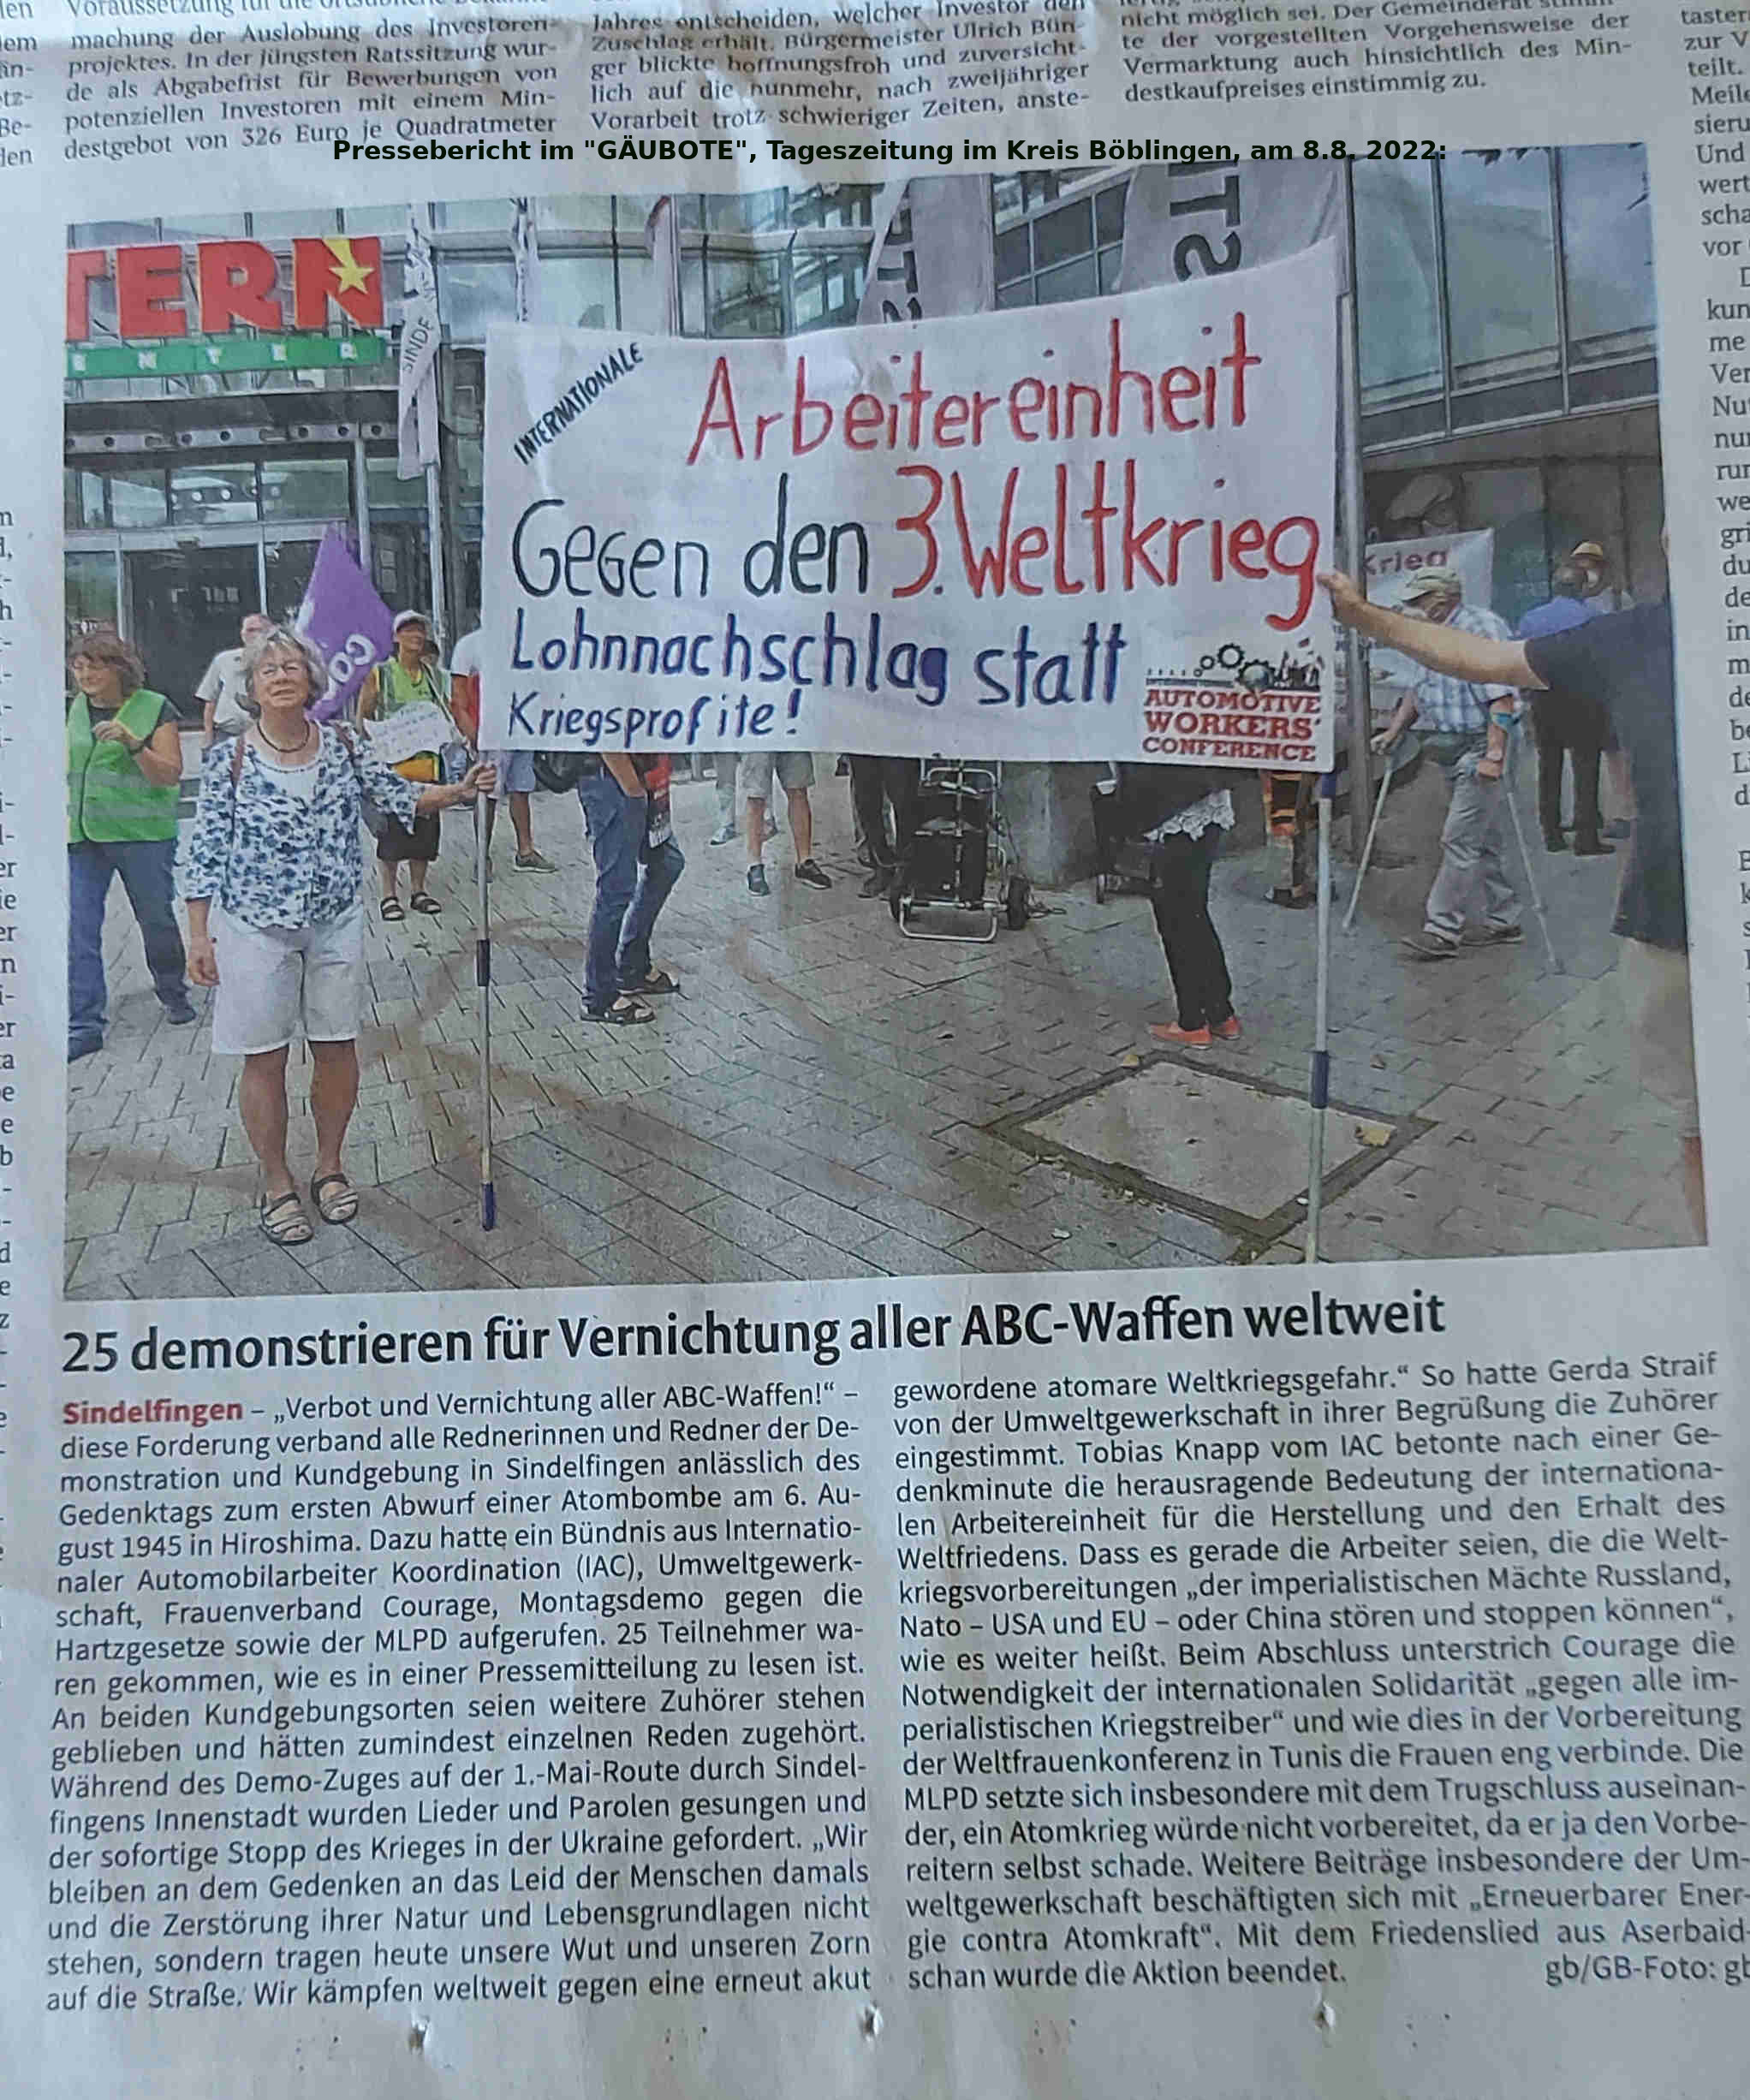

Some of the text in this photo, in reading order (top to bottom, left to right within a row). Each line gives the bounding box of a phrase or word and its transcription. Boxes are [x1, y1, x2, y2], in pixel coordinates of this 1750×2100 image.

[1122, 12, 1630, 51] te der vorgestellten Vorgehensweise der
[1684, 34, 1723, 51] zur
[1124, 38, 1633, 77] Vermarktung auch hinsichtlich des Min-
[1688, 57, 1743, 78] teilt.
[66, 64, 558, 104] de als Abgabefrist für Bewerbungen von
[648, 80, 686, 100] auf
[699, 80, 734, 100] die
[878, 77, 932, 99] nach
[948, 62, 1090, 91] zweijähriger
[1124, 72, 1486, 104] destkaufpreises einstimmig zu.
[65, 87, 557, 135] potenziellen Investoren mit einem Min-
[592, 108, 699, 132] Vorarbeit
[780, 104, 911, 131] schwieriger
[923, 97, 1004, 120] Zeiten,
[1016, 89, 1091, 110] anste-
[64, 116, 557, 163] destgebot von 326 Euro je Quadratmeter
[1696, 142, 1746, 165] Und
[1703, 238, 1741, 258] vor
[66, 236, 384, 342] TERN
[1709, 334, 1746, 353] me
[514, 342, 644, 466] INTERNATIONALE
[686, 311, 1263, 466] Arbeitereinheit
[743, 472, 869, 598] den
[512, 606, 1128, 709] Lohnnachschlag statt
[509, 687, 803, 749] Kriegsprofite!
[1143, 688, 1322, 715] AUTOMOTIVE
[1142, 735, 1317, 763] CONFERENCE
[62, 1287, 1447, 1372] 25 demonstrieren für Vernichtung aller ABC-Waffen weltweit
[62, 1398, 242, 1428] Sindelfingen
[274, 1395, 372, 1424] „Verbot
[380, 1392, 428, 1417] und
[437, 1389, 592, 1417] Vernichtung
[600, 1385, 657, 1410] aller
[894, 1389, 1718, 1437] von der Umweltgewerkschaft in ihrer Begrüßung die Zuhörer
[60, 1482, 861, 1529] Gedenktags zum ersten Abwurf einer Atombombe am 6. Au-
[57, 1581, 863, 1630] schaft, Frauenverband Courage, Montagsdemo gegen die
[900, 1559, 1731, 1609] kriegsvorbereitungen „der imperialistischen Mächte Russland,
[51, 1683, 864, 1731] An beiden Kundgebungsorten seien weitere Zuhörer stehen
[902, 1665, 1739, 1711] Notwendigkeit der internationalen Solidarität „gegen alle im-
[51, 1752, 866, 1799] Während des Demo-Zuges auf der 1.-Mai-Route durch Sindel-
[908, 1928, 946, 1960] gie
[963, 1927, 1048, 1954] contra
[1238, 1921, 1280, 1948] Mit
[1295, 1919, 1357, 1946] dem
[1371, 1917, 1539, 1946] Friedenslied
[1557, 1925, 1606, 1943] aus
[908, 1966, 986, 1990] schan
[993, 1960, 1078, 1988] wurde
[1086, 1959, 1126, 1986] die
[1133, 1958, 1219, 1985] Aktion
[1227, 1955, 1348, 1984] beendet.
[1546, 1954, 1716, 1987] gb/GB-Foto:
